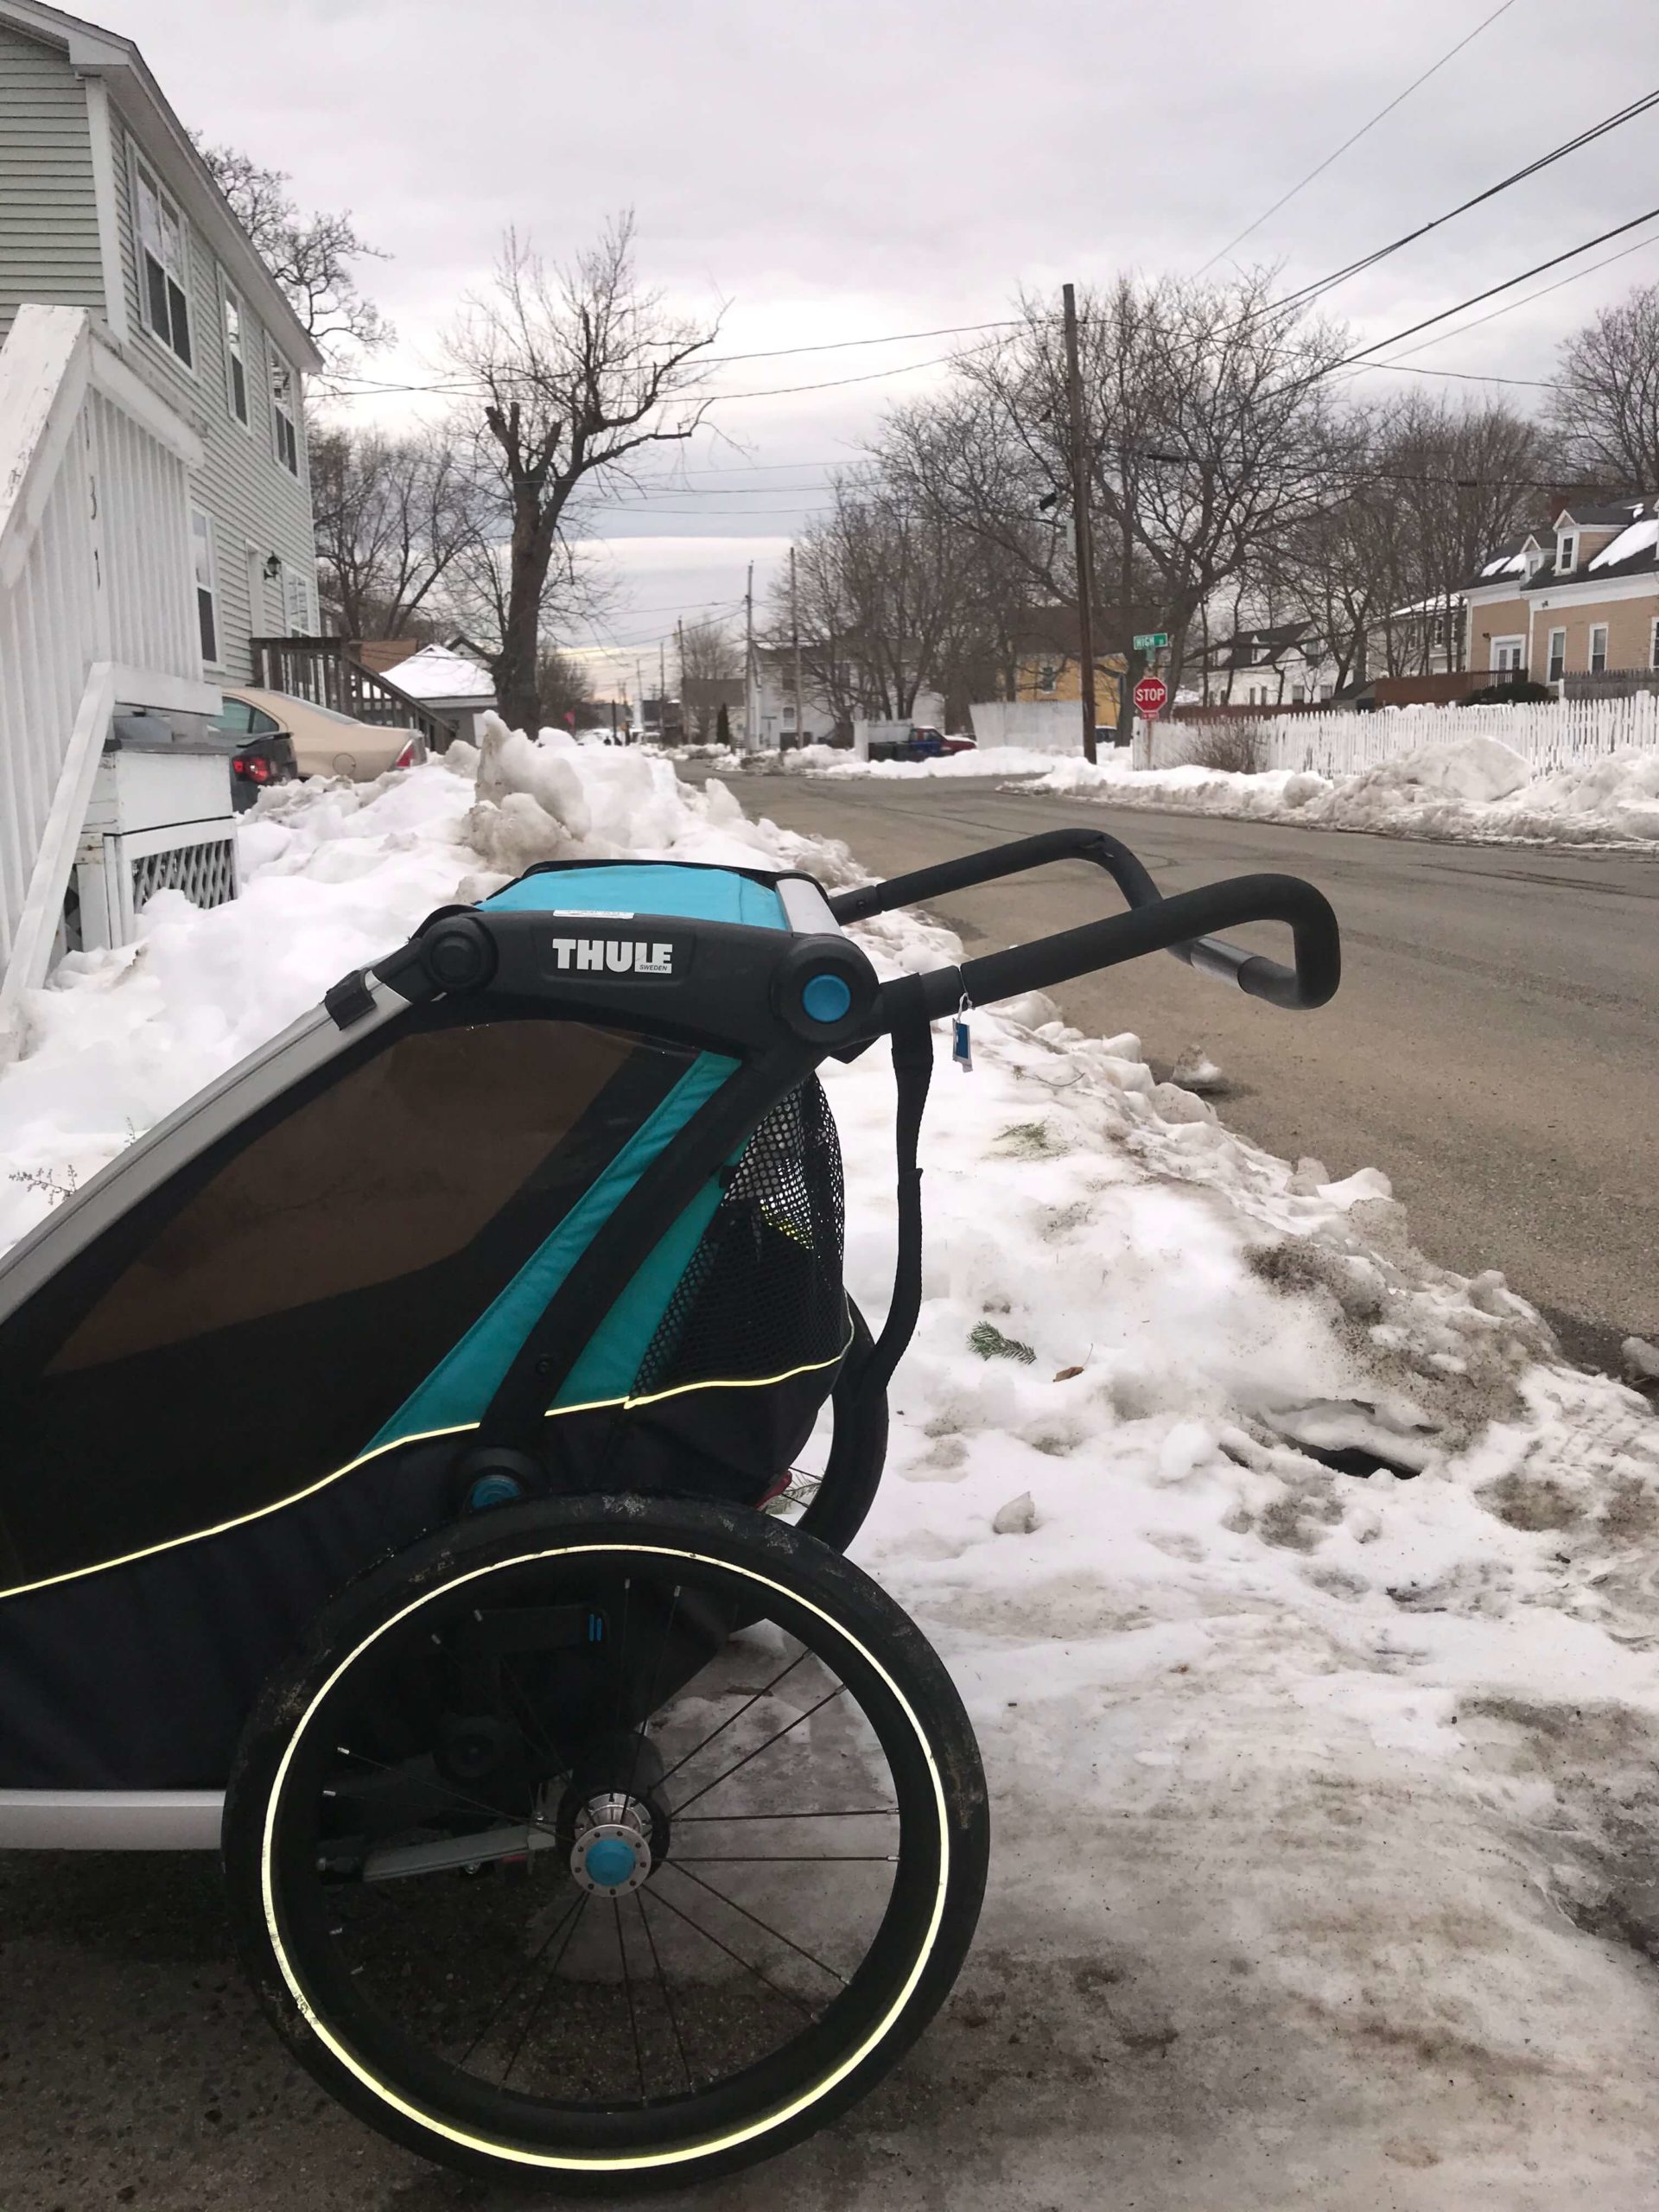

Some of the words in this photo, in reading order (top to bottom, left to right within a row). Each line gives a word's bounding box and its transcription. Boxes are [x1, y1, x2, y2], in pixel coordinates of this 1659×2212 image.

[1136, 637, 1154, 647] HIGH
[1136, 689, 1165, 702] STOP
[552, 938, 673, 974] THULE
